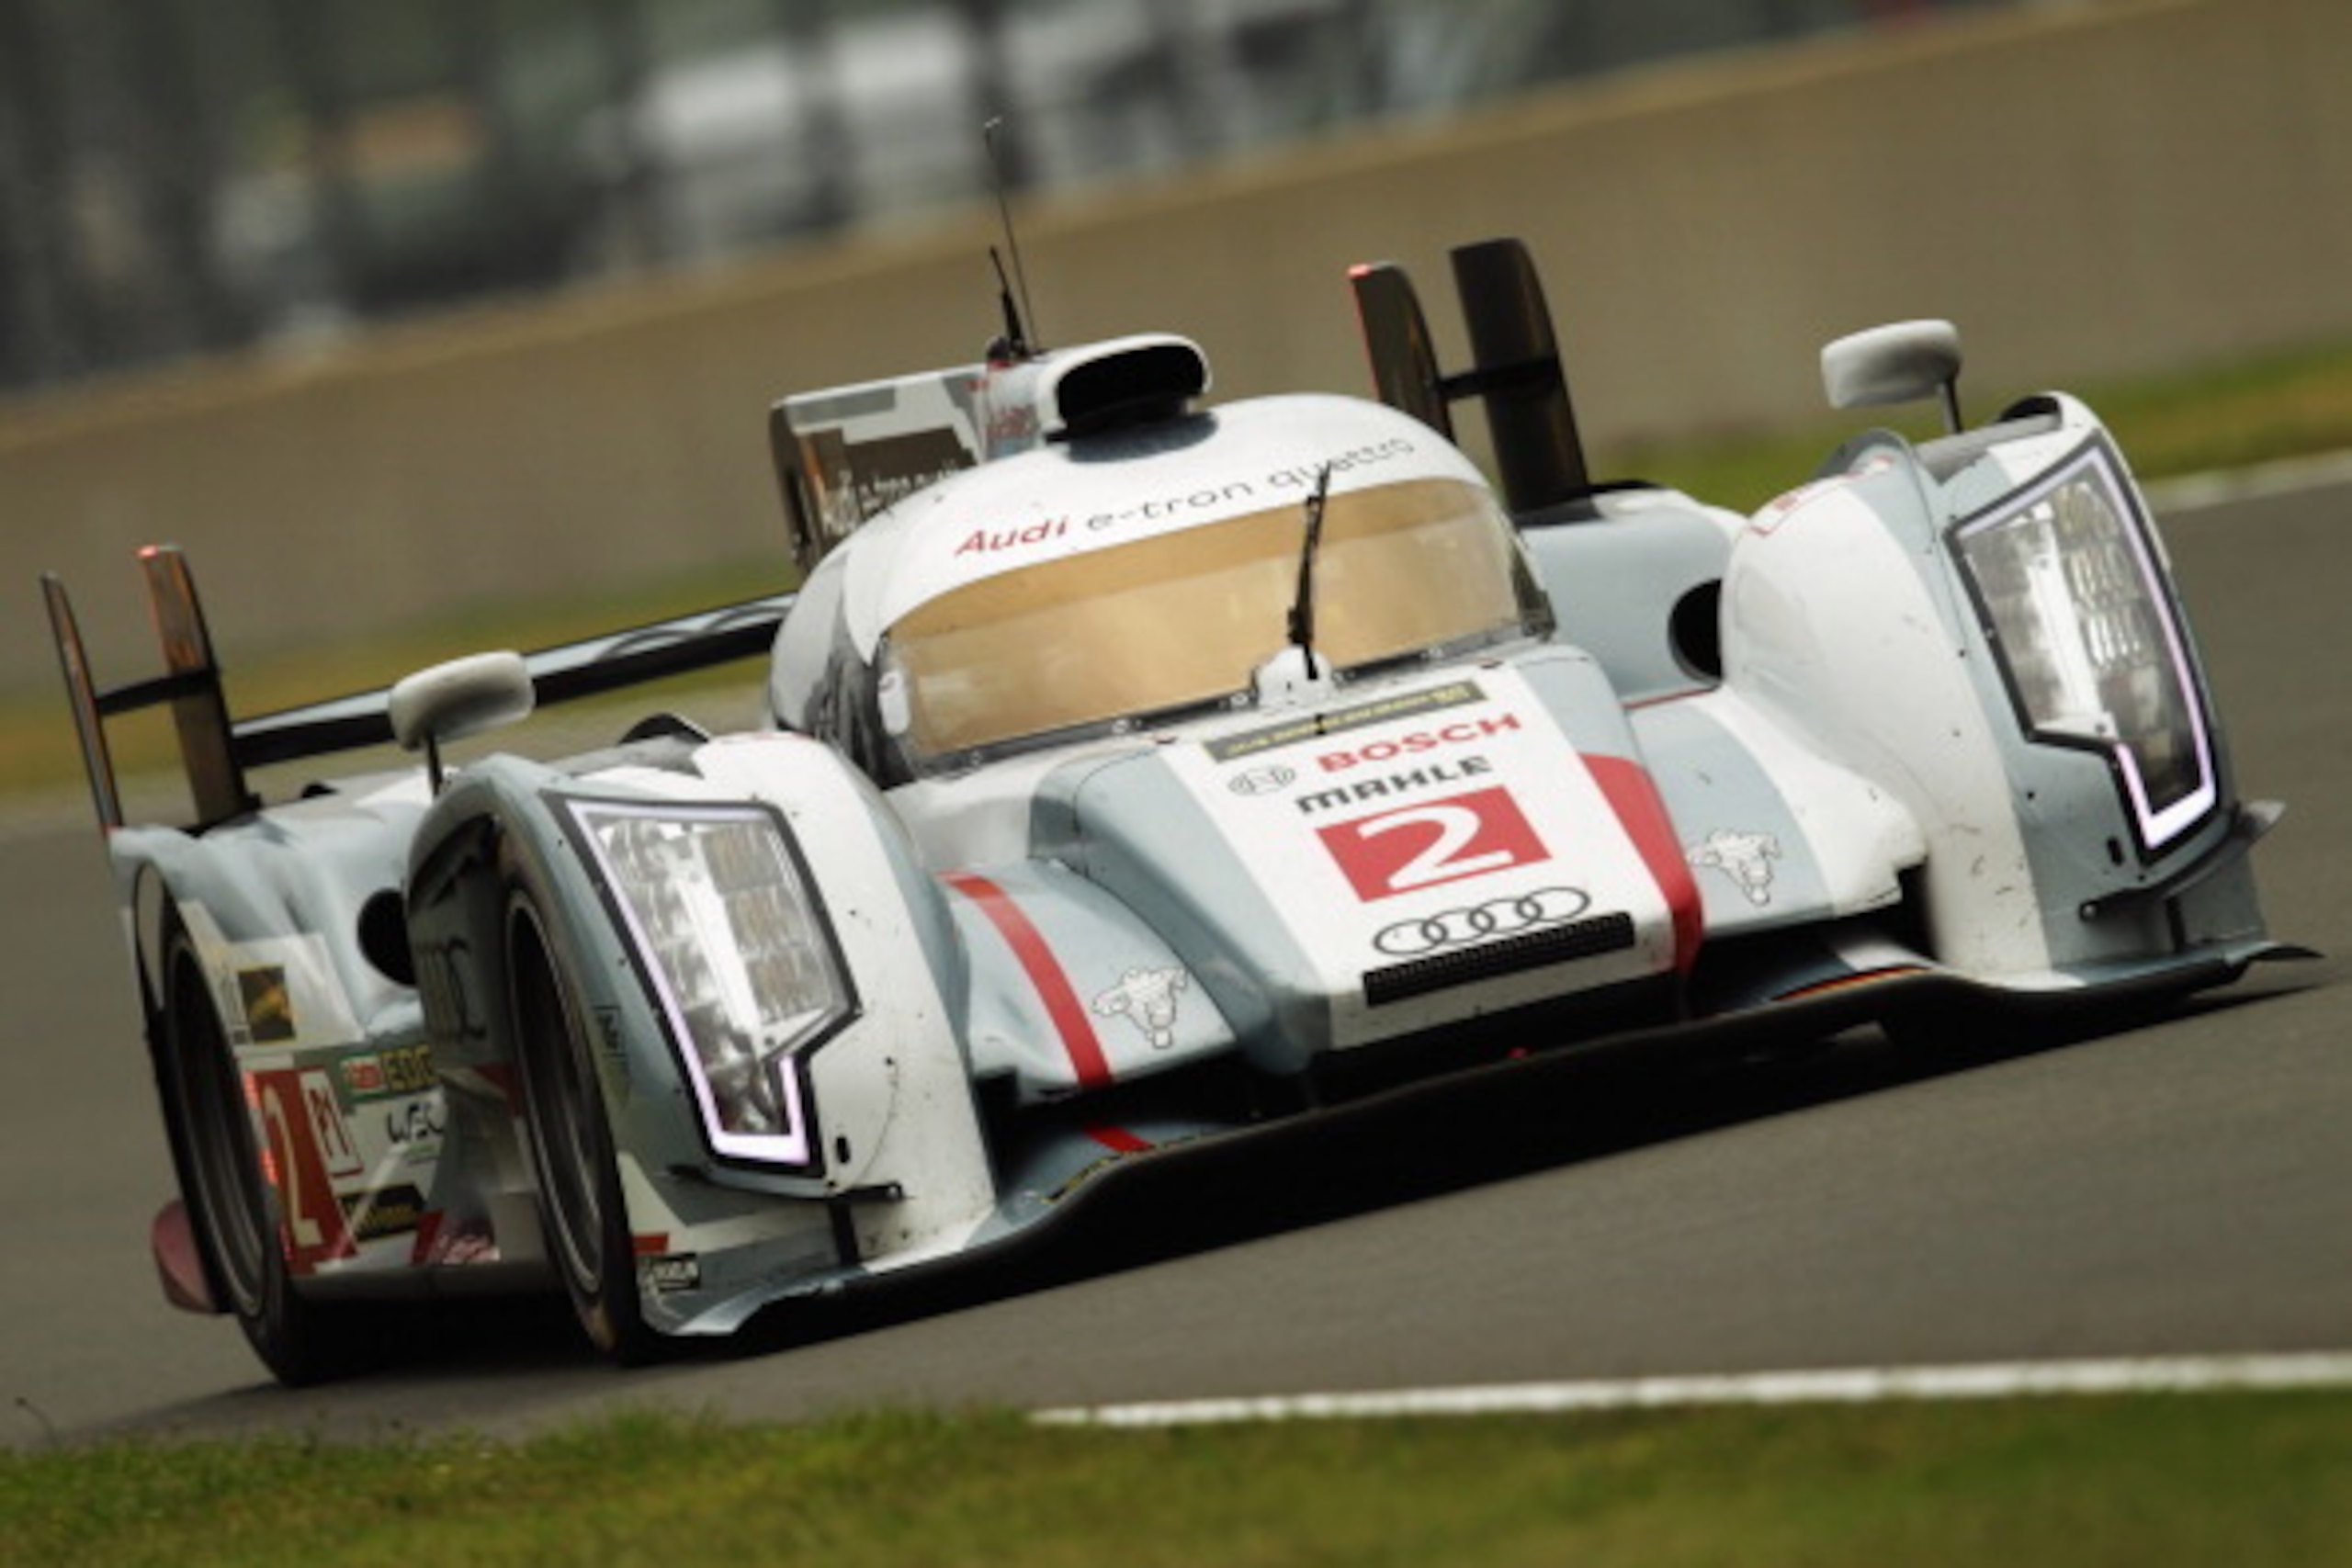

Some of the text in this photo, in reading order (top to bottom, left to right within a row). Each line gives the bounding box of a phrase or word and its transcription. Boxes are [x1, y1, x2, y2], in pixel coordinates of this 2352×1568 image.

[955, 436, 1416, 557] Audi e-tron quattro
[1316, 713, 1522, 773] BOSCH
[1295, 755, 1493, 814] MAHLE
[1356, 803, 1515, 890] 2
